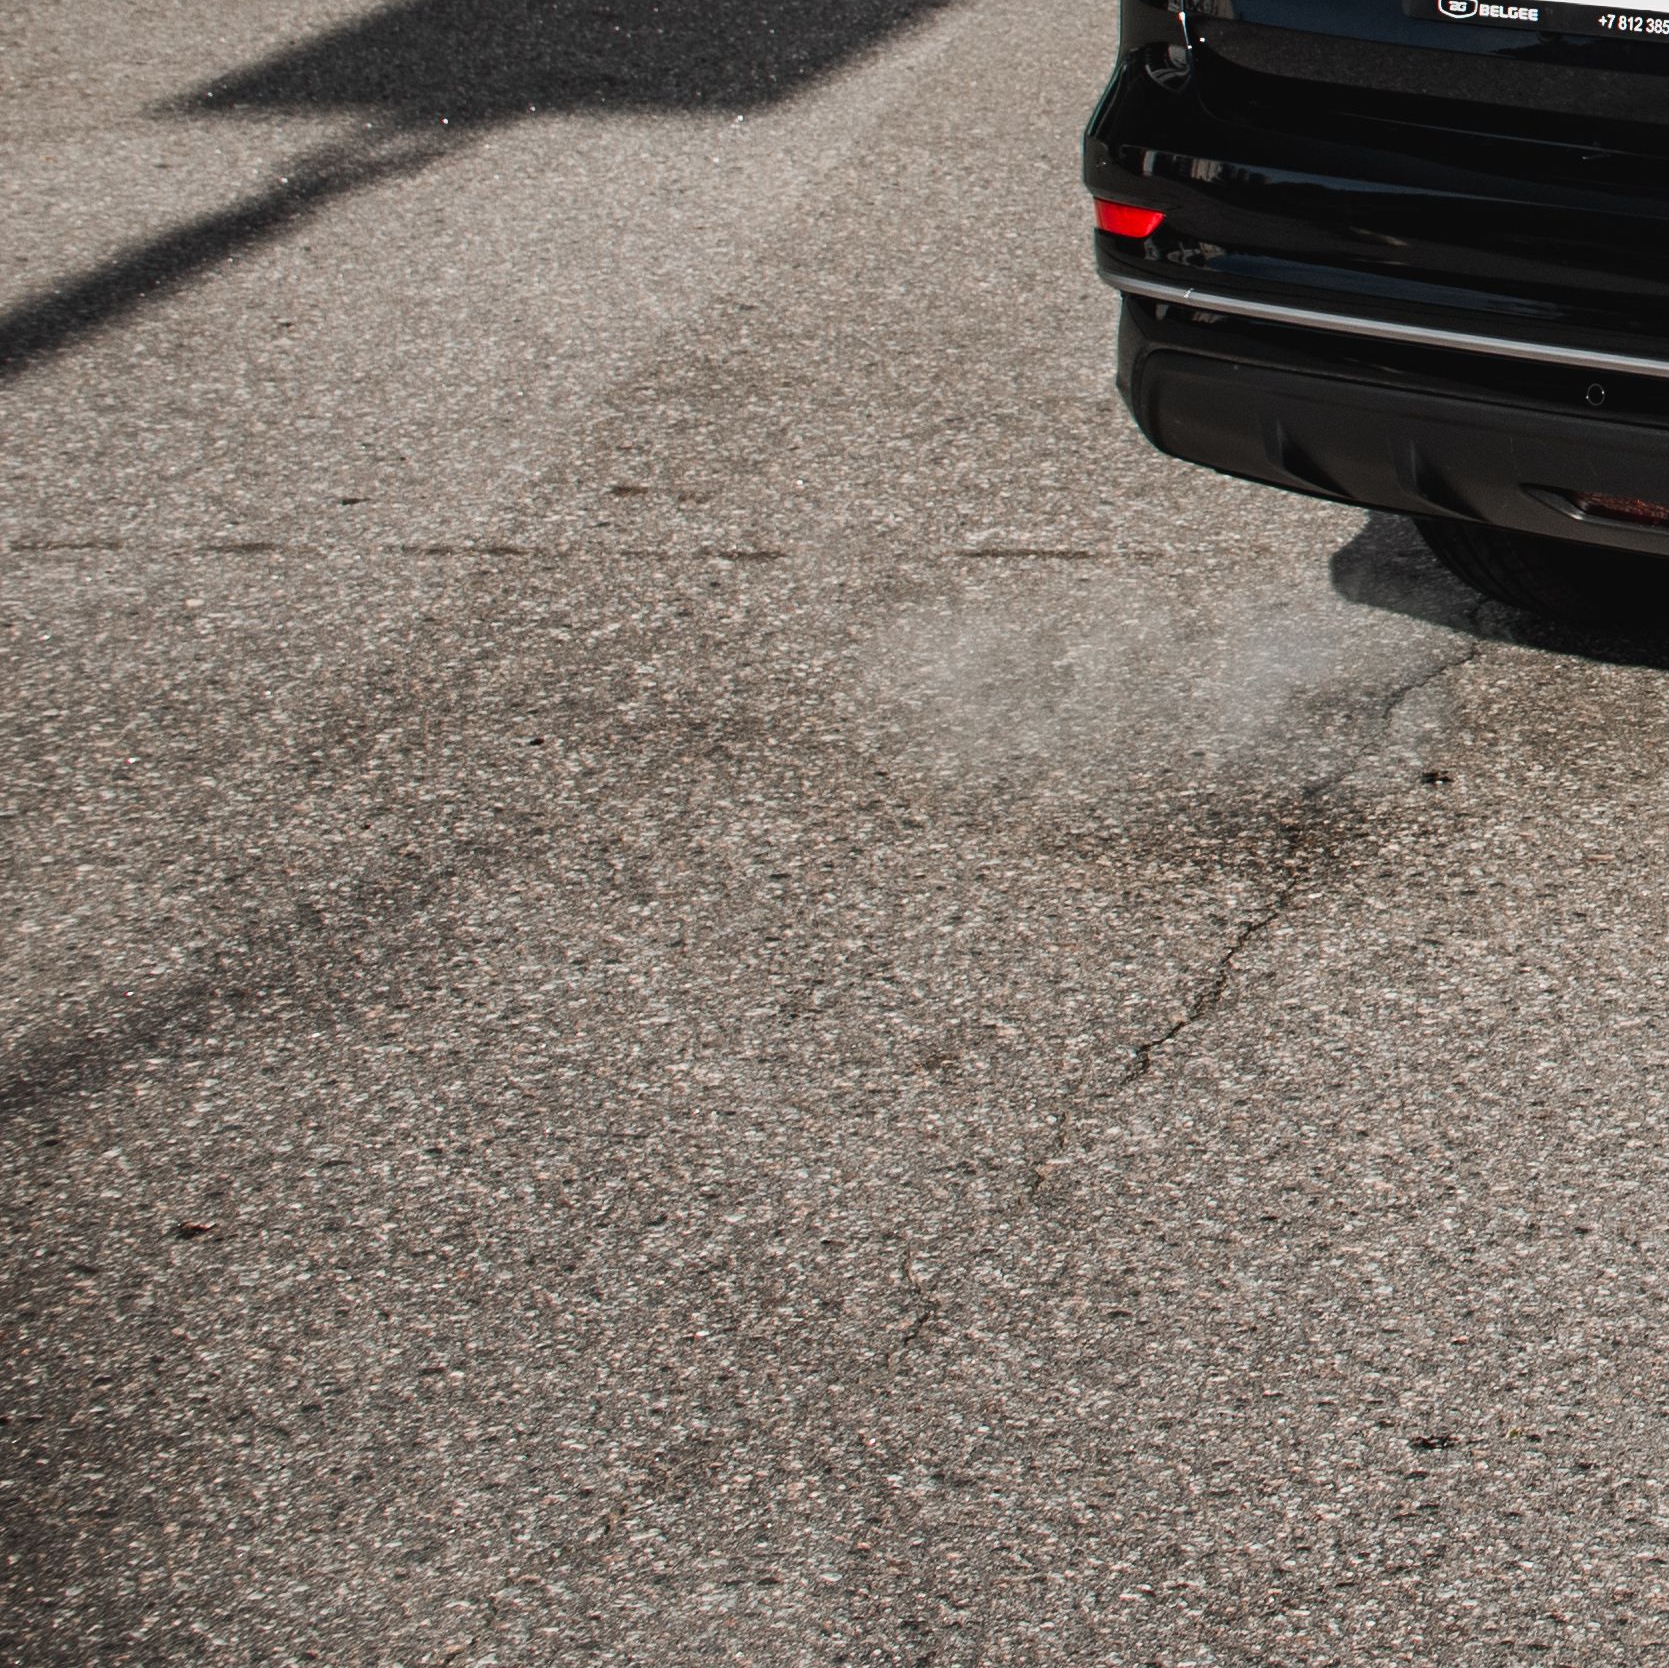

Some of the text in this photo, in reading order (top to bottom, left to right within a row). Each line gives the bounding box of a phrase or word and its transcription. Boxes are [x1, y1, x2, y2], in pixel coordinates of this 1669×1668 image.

[1478, 3, 1539, 22] BELGEE
[1598, 13, 1616, 30] +7
[1618, 15, 1643, 32] 812
